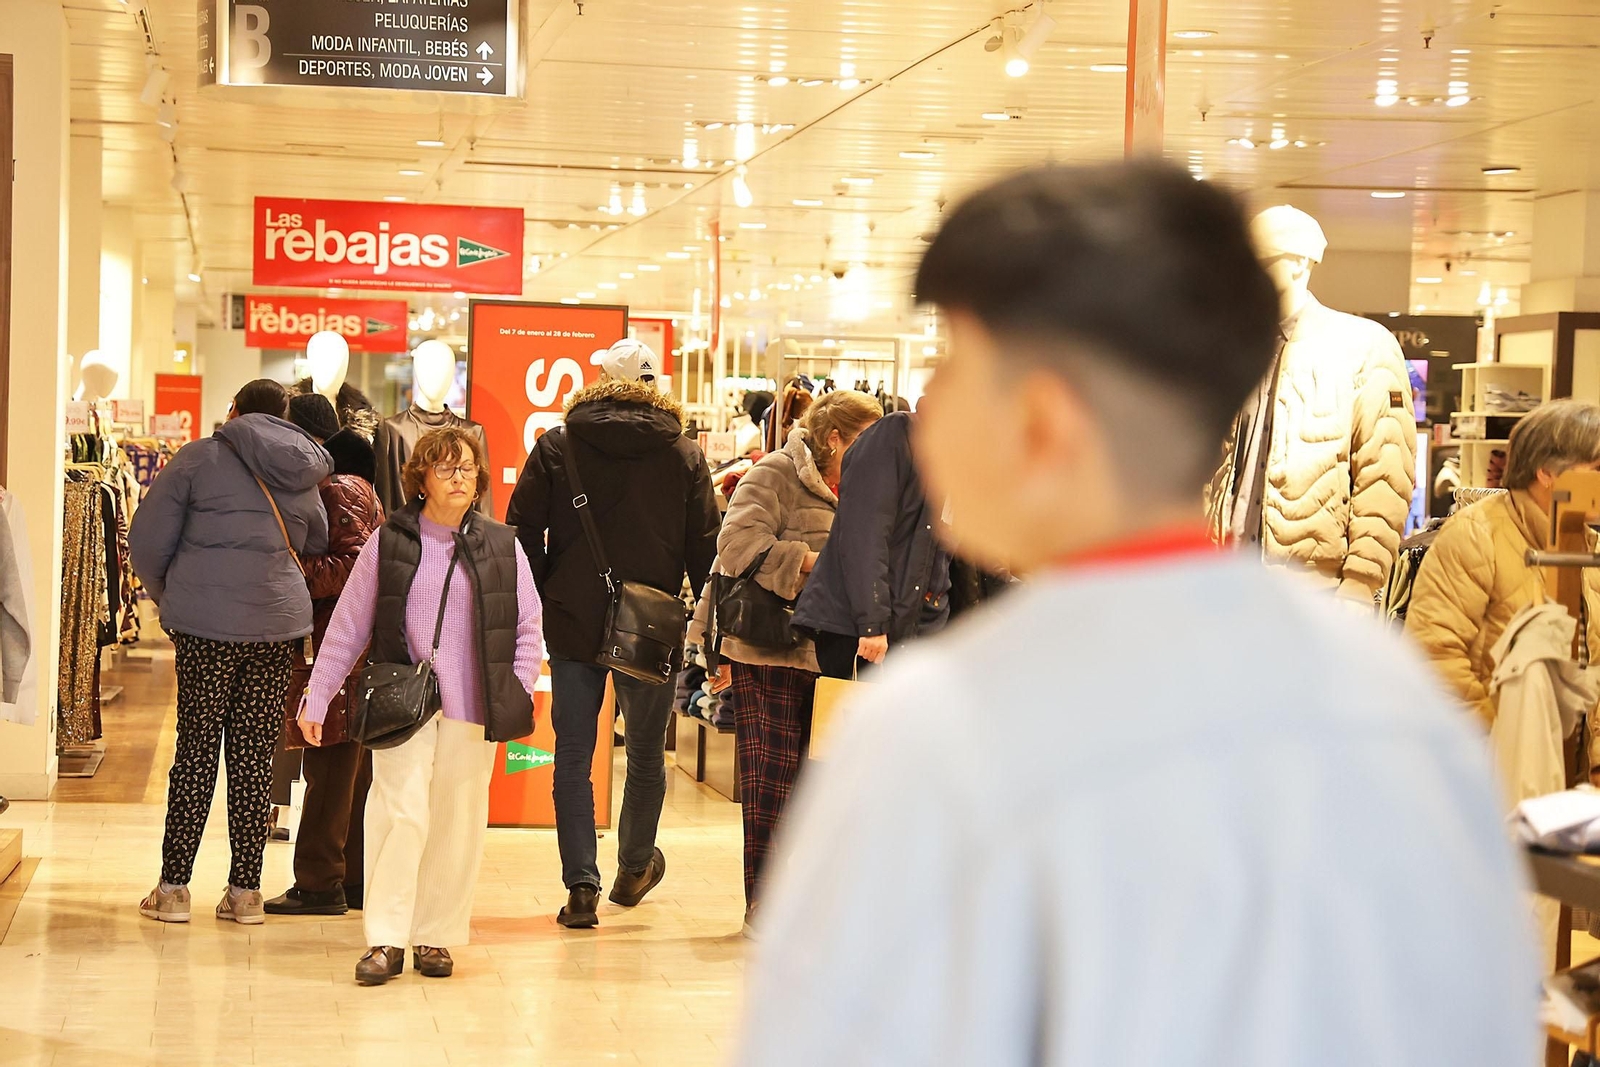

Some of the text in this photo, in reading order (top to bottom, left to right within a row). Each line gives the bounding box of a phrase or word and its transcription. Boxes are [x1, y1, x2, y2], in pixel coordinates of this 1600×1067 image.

[375, 13, 468, 32] PELUQUERÍAS
[236, 5, 271, 68] B
[312, 35, 468, 57] MODA INFANTIL, BEBÉS
[299, 60, 468, 82] DEPORTES, MODA JOVEN
[265, 208, 302, 228] Las
[265, 219, 450, 275] rebajas
[250, 300, 274, 313] Las
